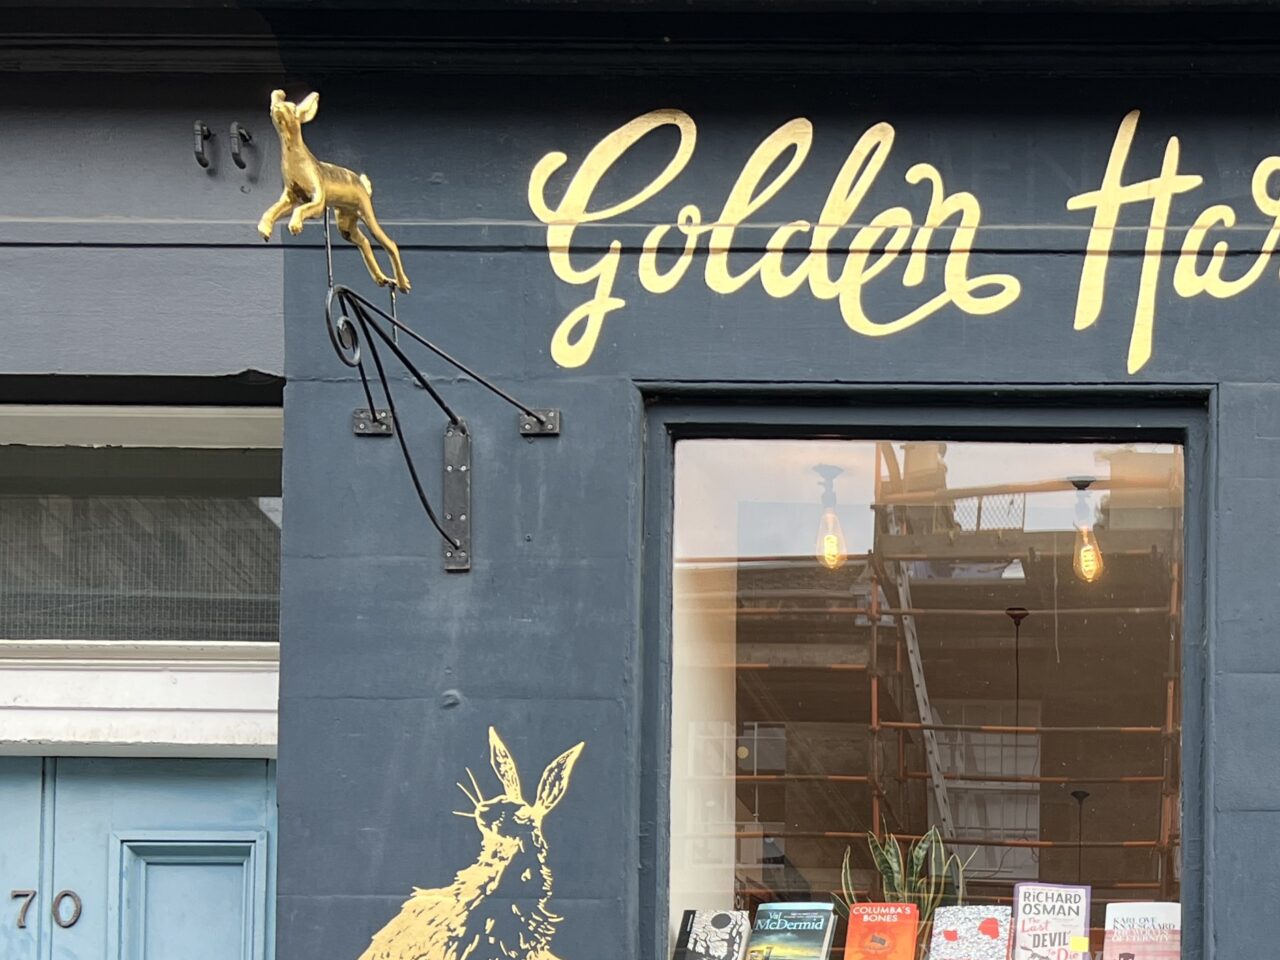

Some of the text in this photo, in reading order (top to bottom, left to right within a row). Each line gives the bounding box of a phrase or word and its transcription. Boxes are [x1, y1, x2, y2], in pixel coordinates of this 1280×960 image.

[528, 108, 1021, 368] Golden
[11, 890, 82, 929] 70
[768, 912, 782, 920] Val
[853, 906, 911, 915] COLUMBA'S
[1022, 903, 1080, 916] OSMAN
[755, 916, 824, 930] McDermid
[862, 915, 898, 923] BONES
[1022, 919, 1050, 933] Last
